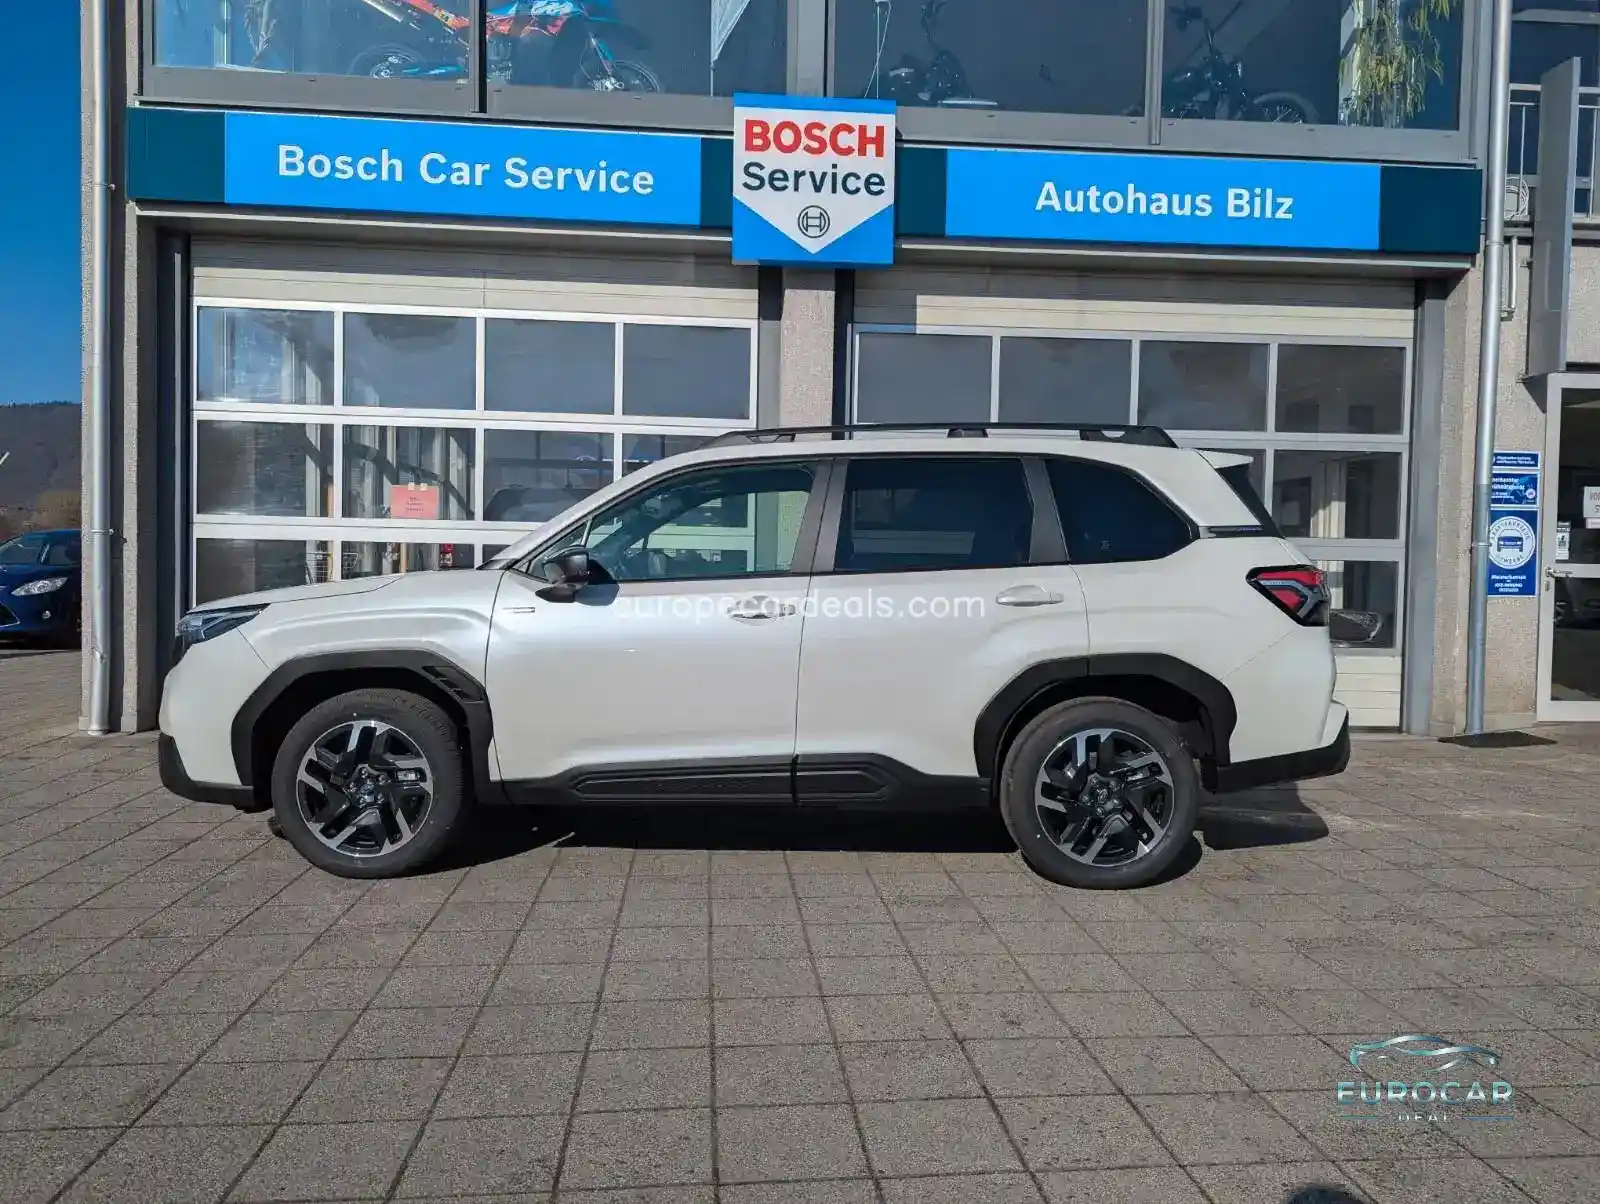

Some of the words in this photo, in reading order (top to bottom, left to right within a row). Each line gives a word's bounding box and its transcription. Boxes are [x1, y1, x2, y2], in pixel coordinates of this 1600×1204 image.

[744, 119, 885, 158] BOSCH
[277, 144, 402, 182] Bosch
[419, 152, 491, 186] Car
[503, 157, 654, 195] Service
[742, 161, 886, 196] Service
[1035, 181, 1212, 217] Autohaus
[1226, 187, 1294, 220] Bilz
